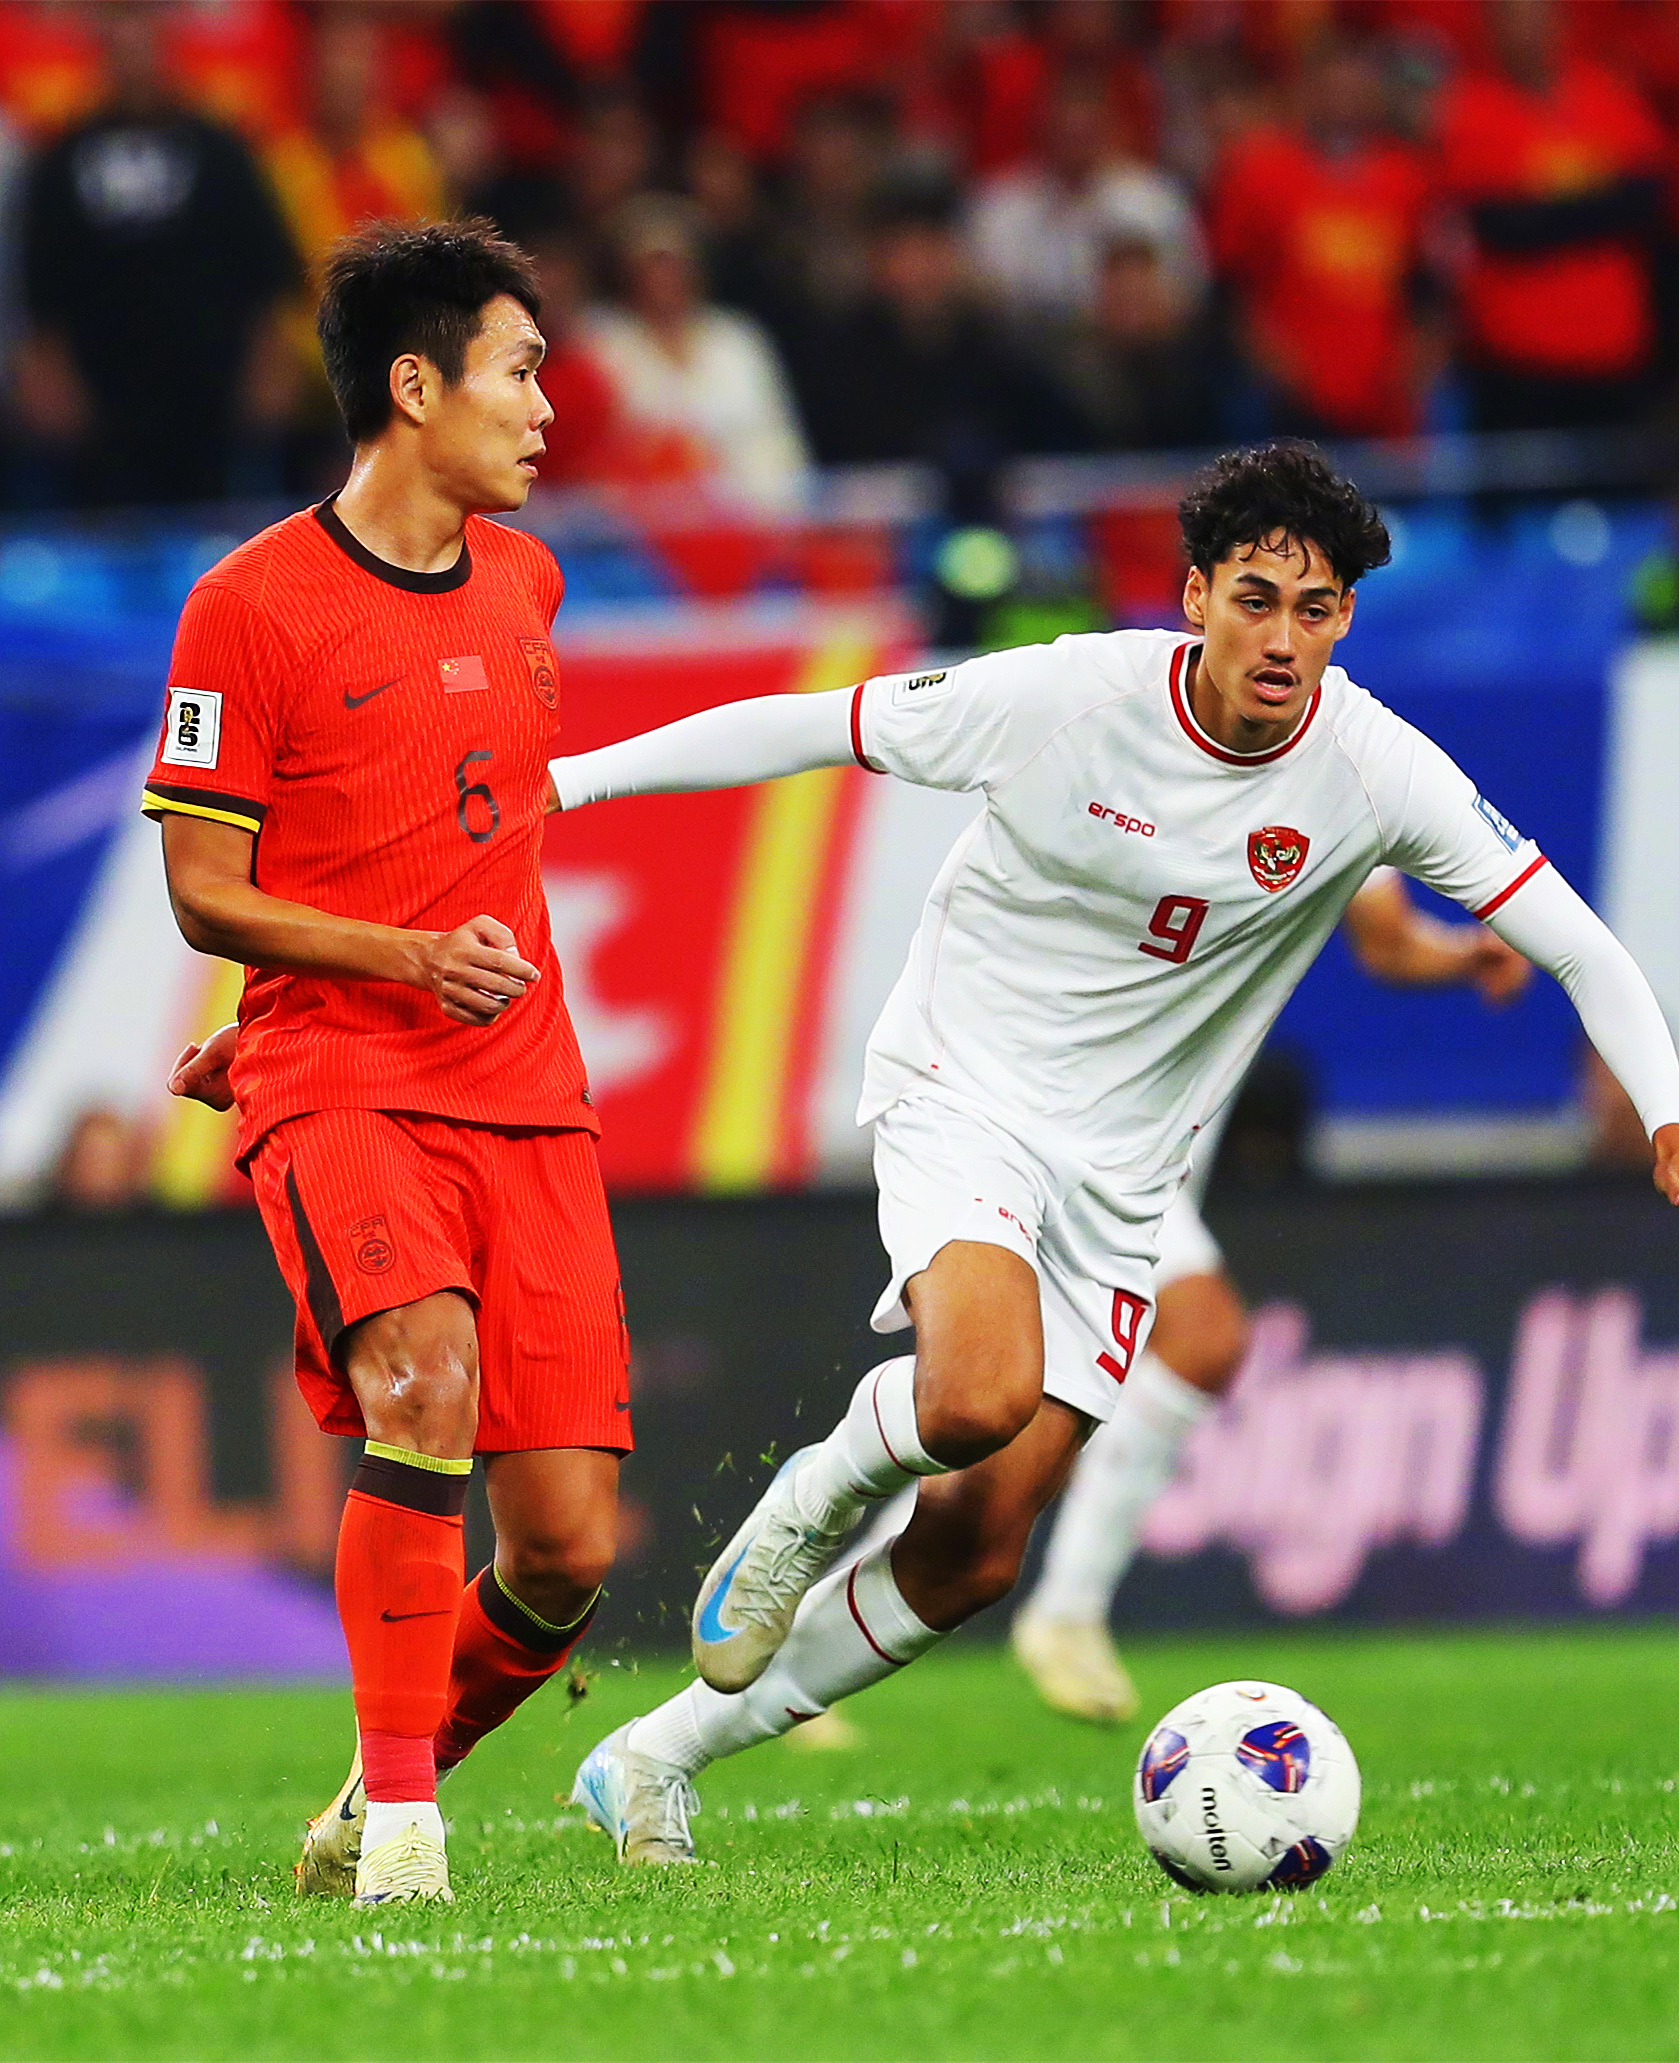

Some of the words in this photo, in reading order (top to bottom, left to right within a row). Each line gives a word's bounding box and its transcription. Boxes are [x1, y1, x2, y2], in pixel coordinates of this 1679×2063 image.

[454, 750, 500, 843] 6
[1087, 801, 1156, 838] erspo
[1137, 894, 1210, 964] 9
[1095, 1287, 1151, 1385] 9
[1200, 1786, 1233, 1872] molten
